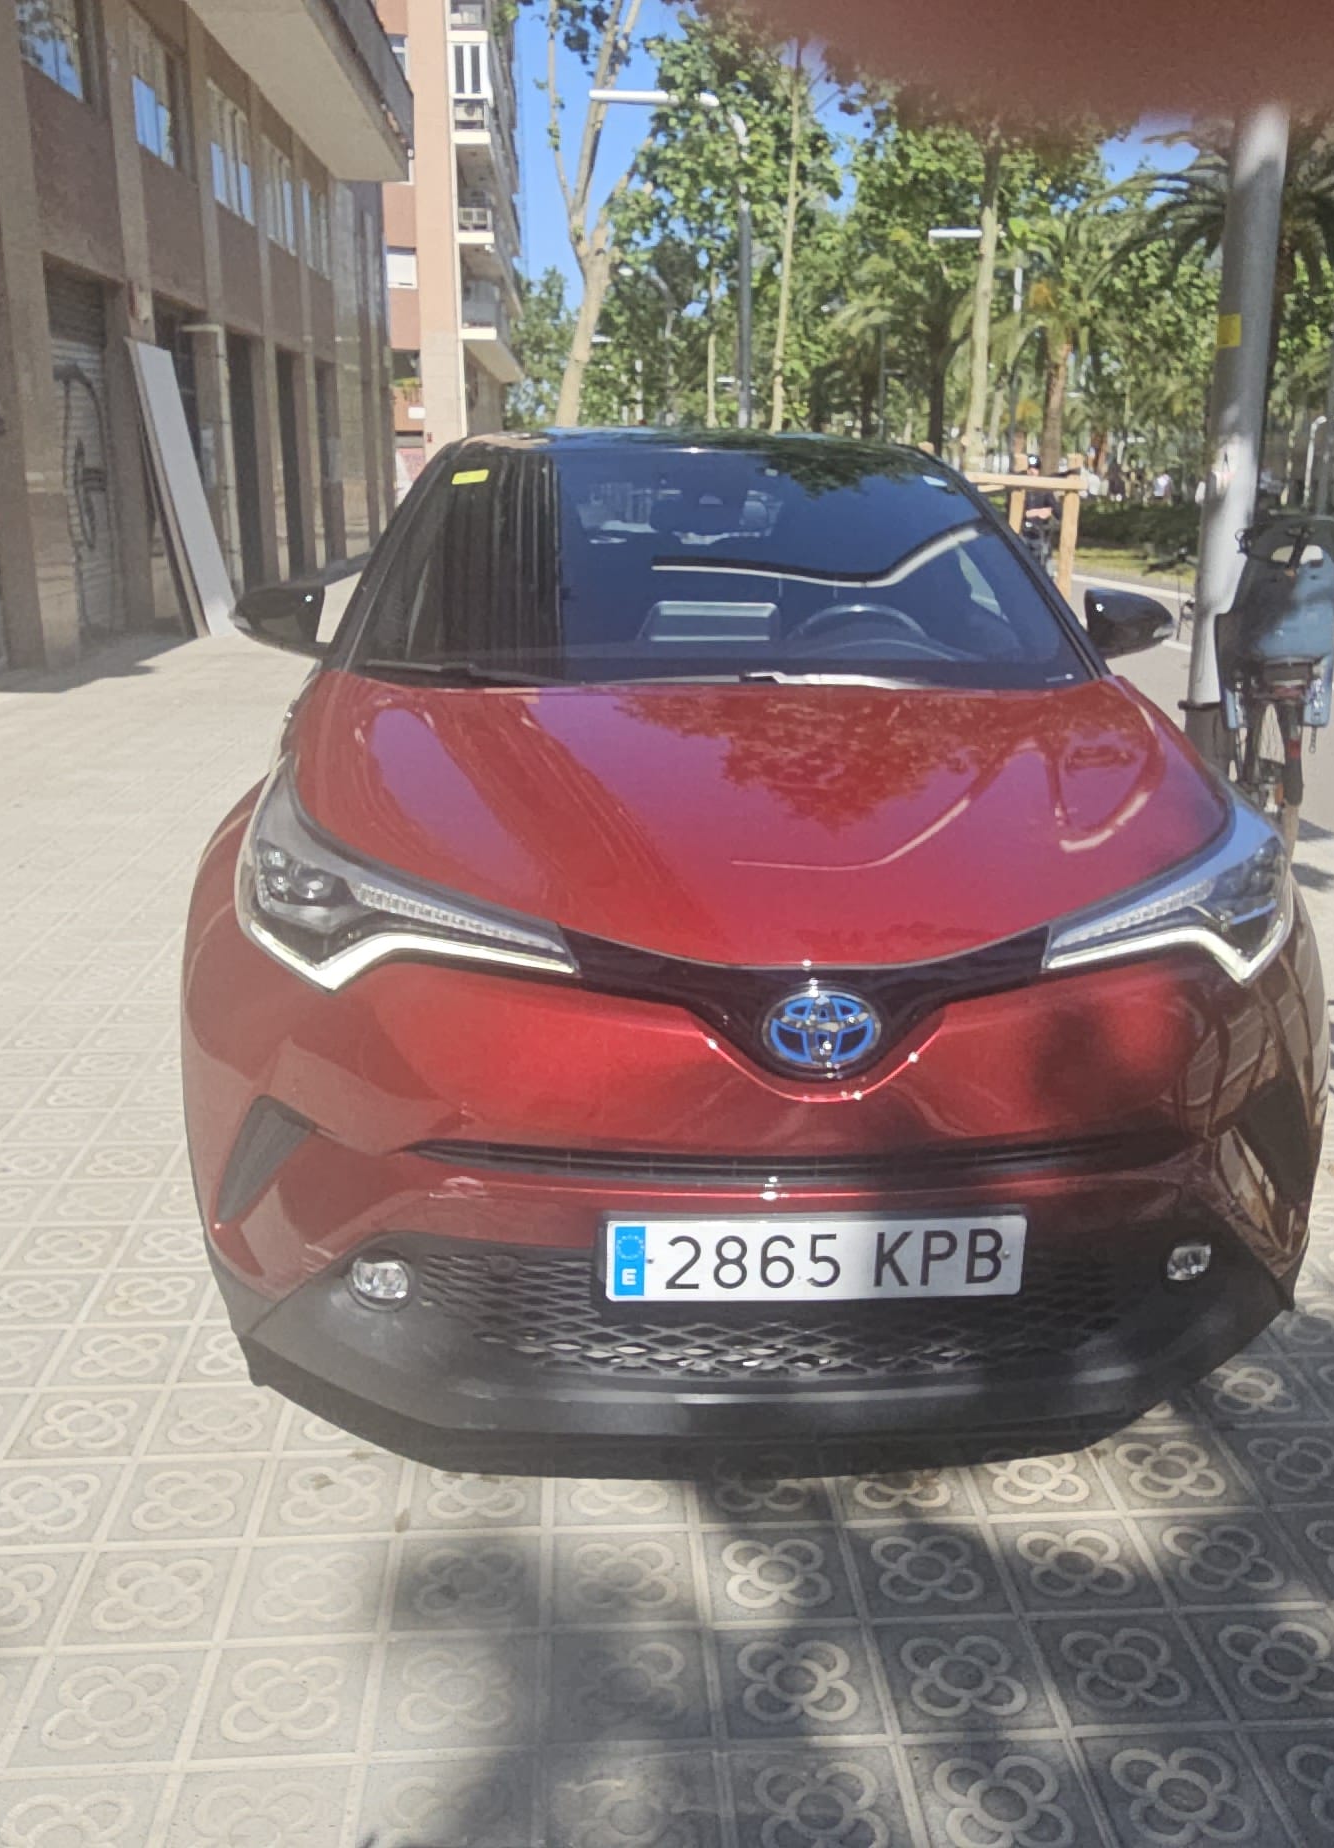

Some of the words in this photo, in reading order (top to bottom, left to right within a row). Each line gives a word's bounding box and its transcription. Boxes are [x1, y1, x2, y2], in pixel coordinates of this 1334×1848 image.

[621, 1268, 637, 1286] E
[665, 1234, 841, 1290] 2865
[872, 1228, 1004, 1287] KPB
